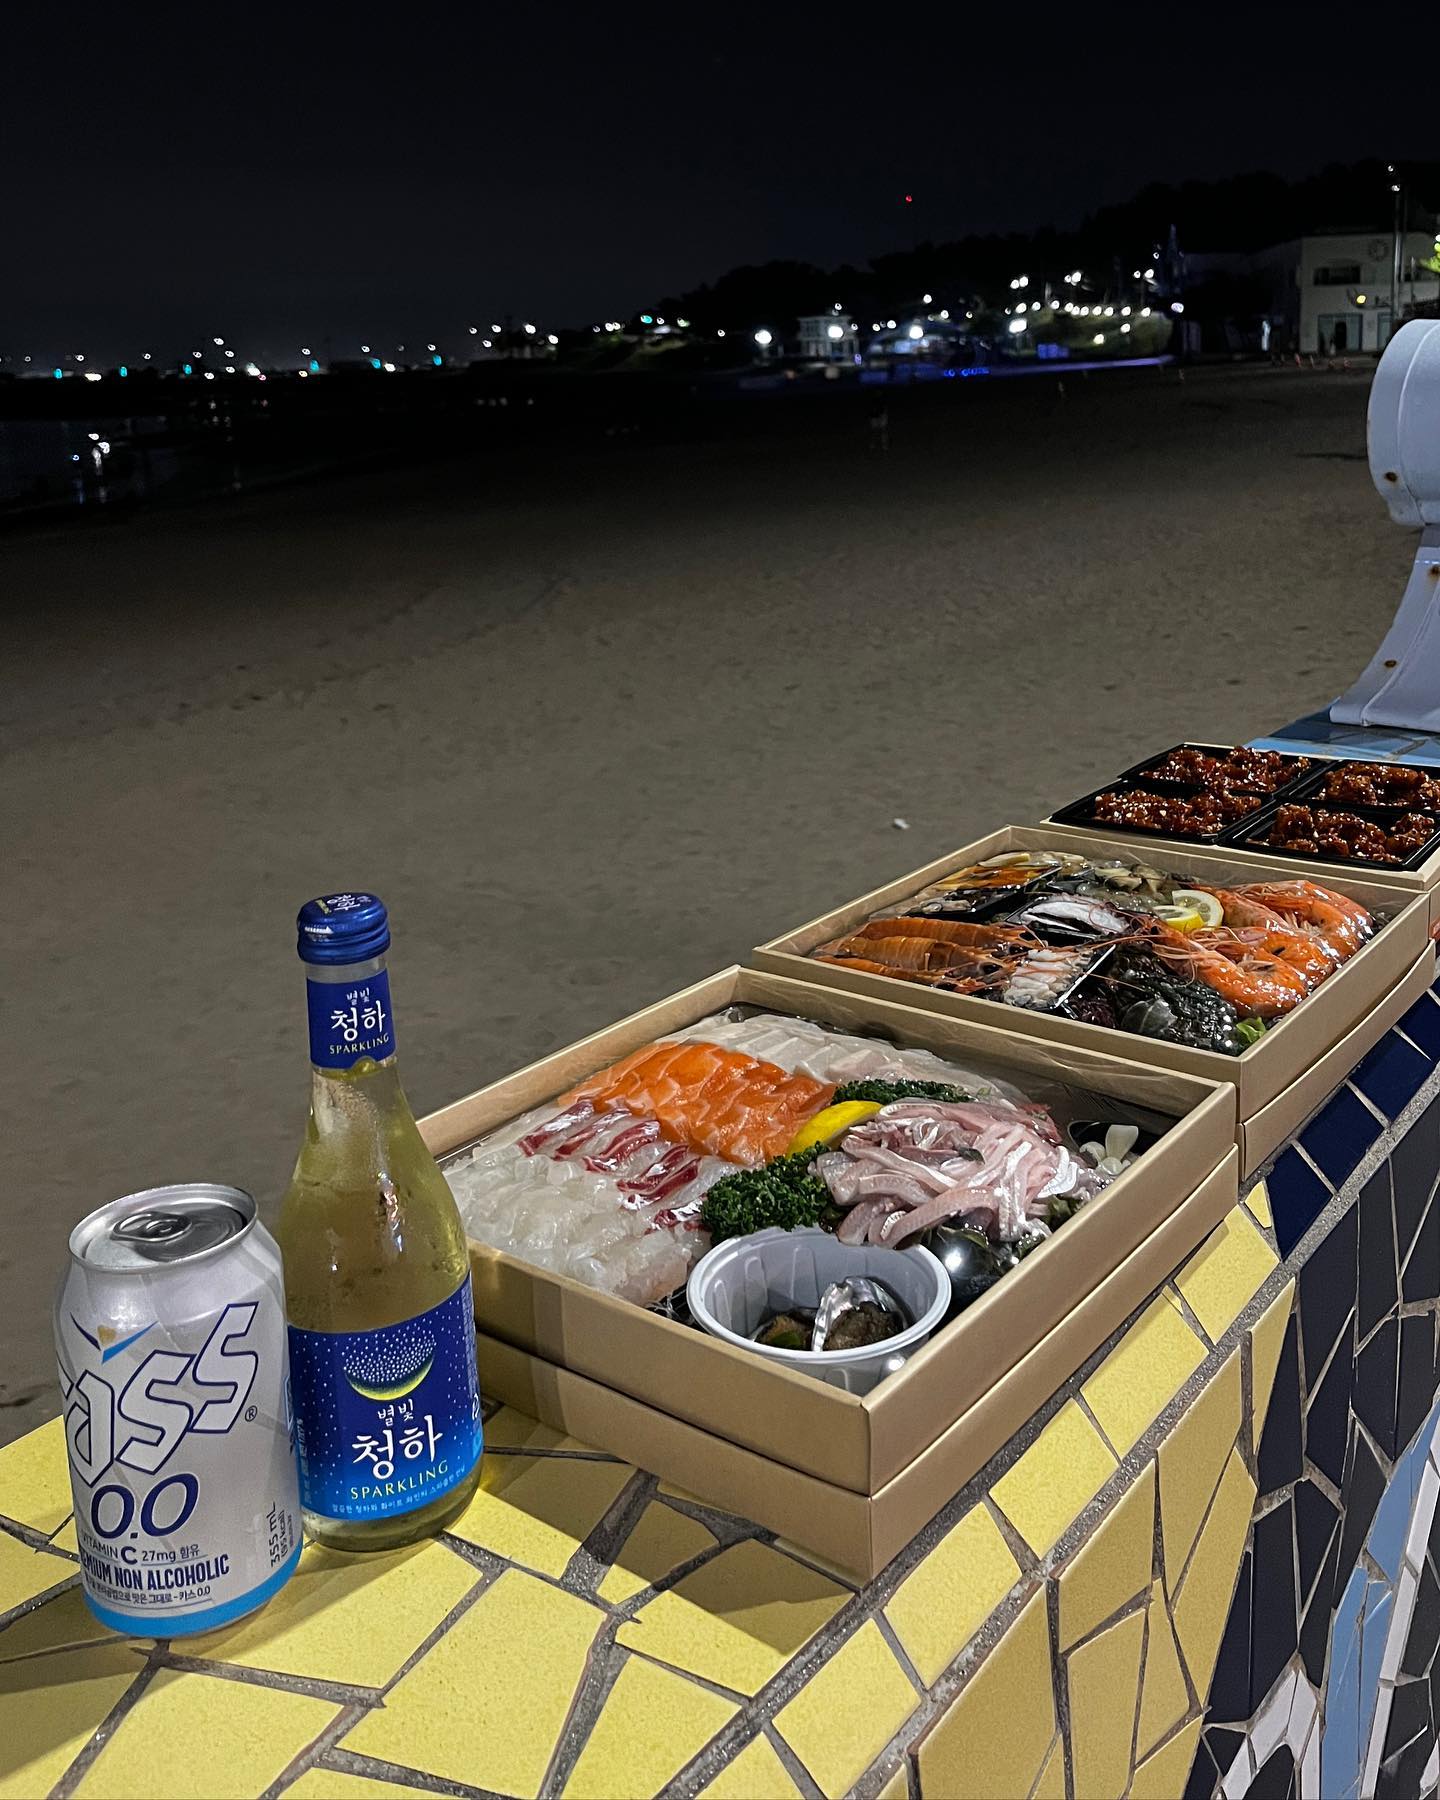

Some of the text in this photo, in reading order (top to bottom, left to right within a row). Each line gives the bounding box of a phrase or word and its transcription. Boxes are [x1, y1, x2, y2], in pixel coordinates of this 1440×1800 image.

[346, 987, 370, 1006] 별빛
[330, 1000, 386, 1041] 청하
[329, 1032, 389, 1054] SPARKLING
[377, 1399, 414, 1427] 별빛
[352, 1414, 443, 1480] 청하
[351, 1459, 449, 1500] SPARKLING
[91, 1473, 199, 1540] 0.0
[121, 1546, 137, 1564] C
[141, 1550, 176, 1563] 27mg
[180, 1544, 200, 1558] 함유
[266, 1501, 281, 1568] 355 mL
[115, 1569, 142, 1590] NON
[147, 1553, 230, 1591] ALCOHOLIC
